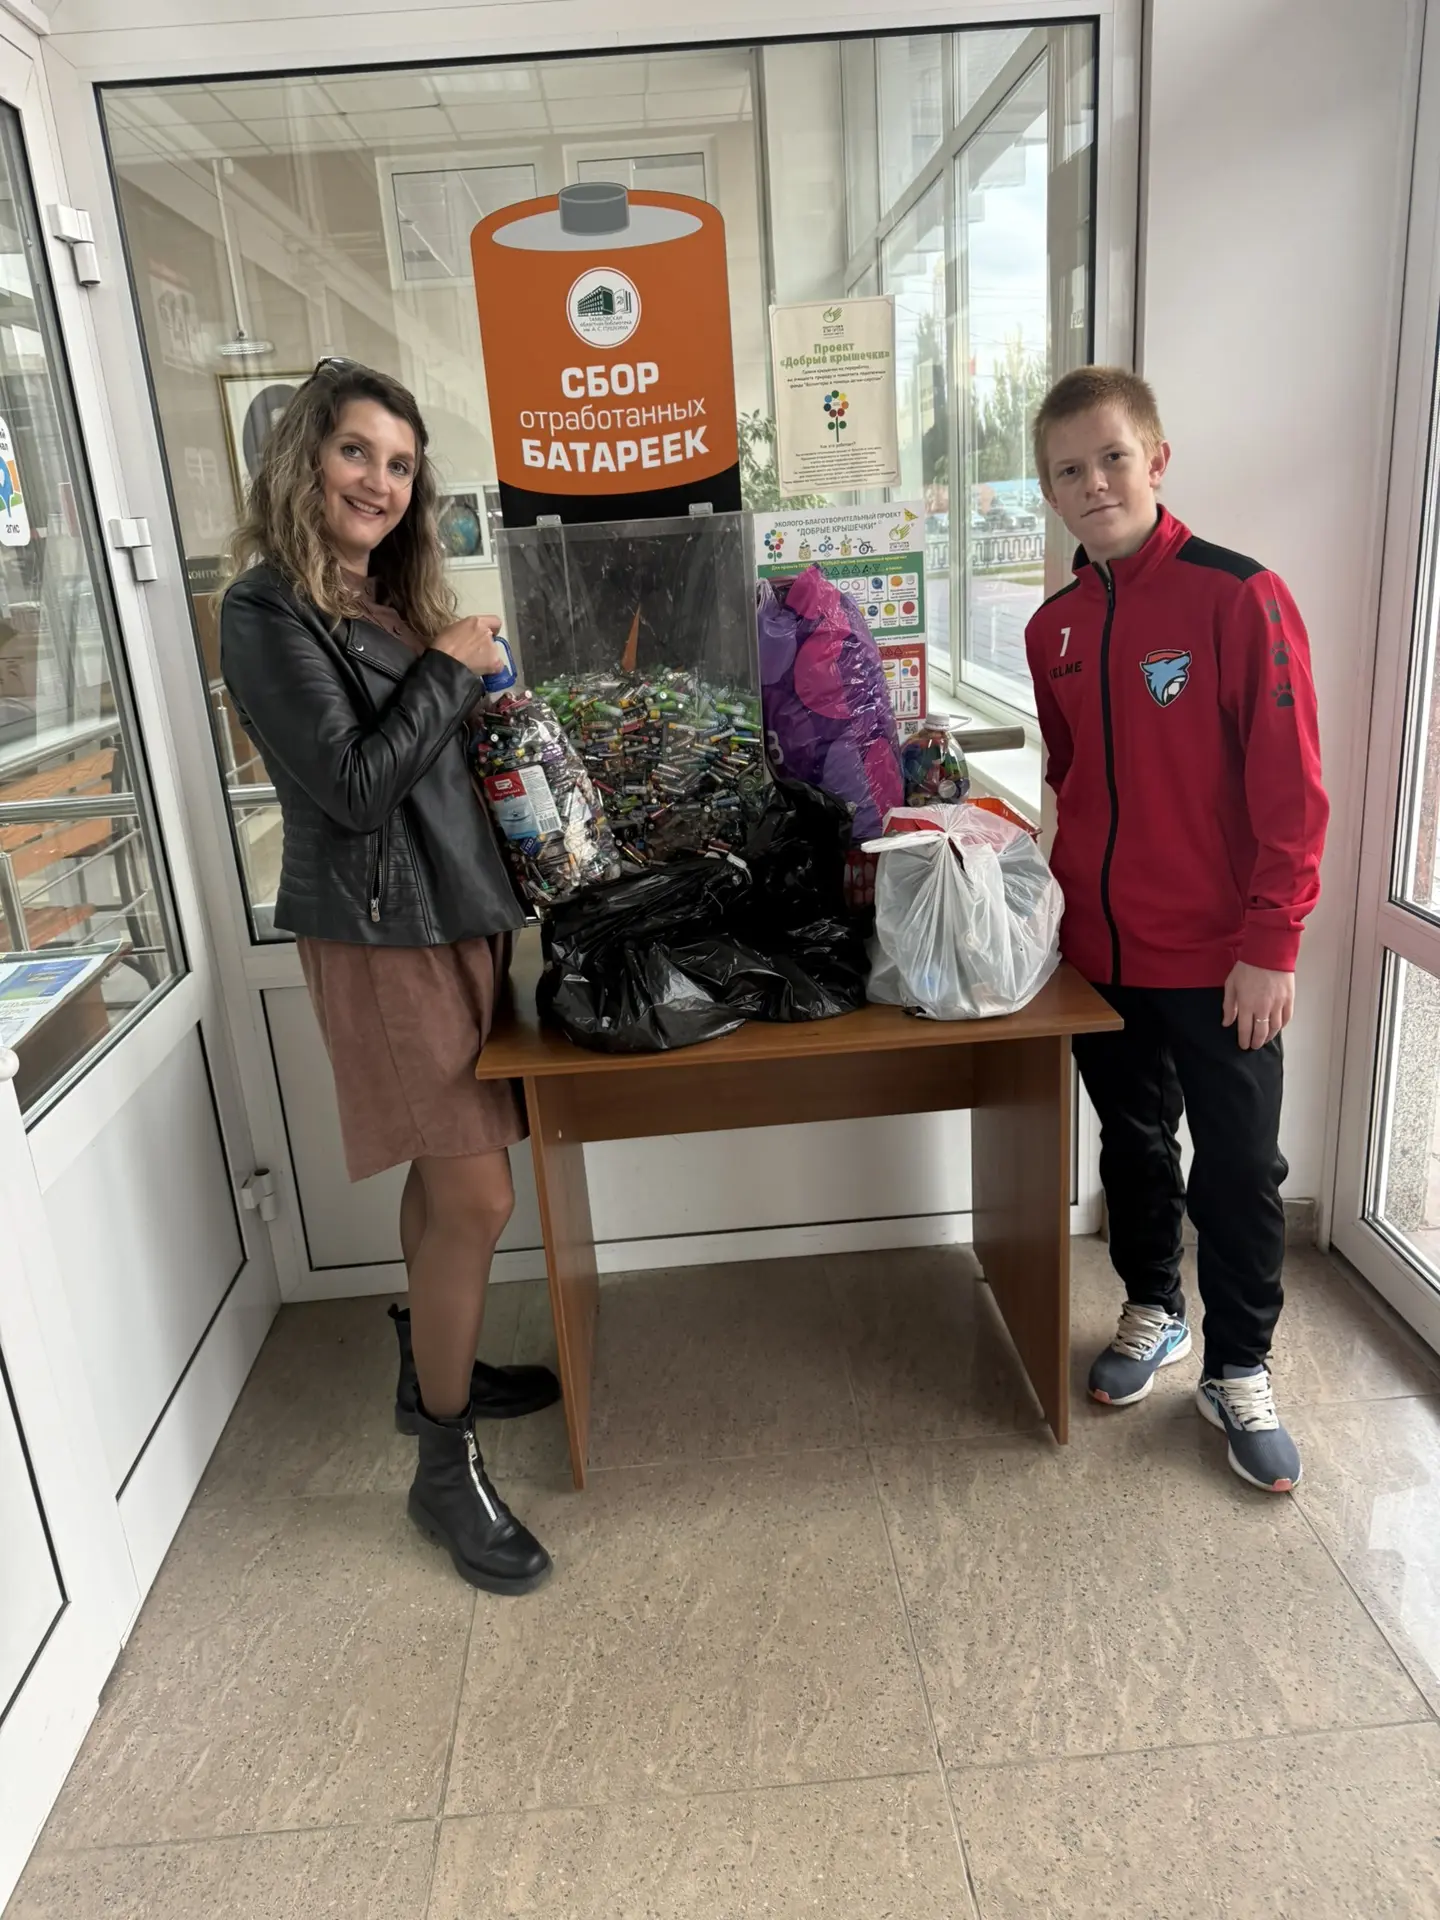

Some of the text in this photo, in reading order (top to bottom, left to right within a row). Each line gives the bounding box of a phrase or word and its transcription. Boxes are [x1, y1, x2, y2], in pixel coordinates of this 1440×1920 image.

[780, 354, 828, 369] «Добрые
[814, 343, 855, 355] Проект
[561, 361, 660, 399] СБОР
[520, 397, 707, 437] отработанных
[521, 425, 710, 473] БАТАРЕЕК
[774, 511, 901, 529] ЭКОЛОГО-БЛАГОТВОРИТЕЛЬНЫЙ ПРОЕКТ
